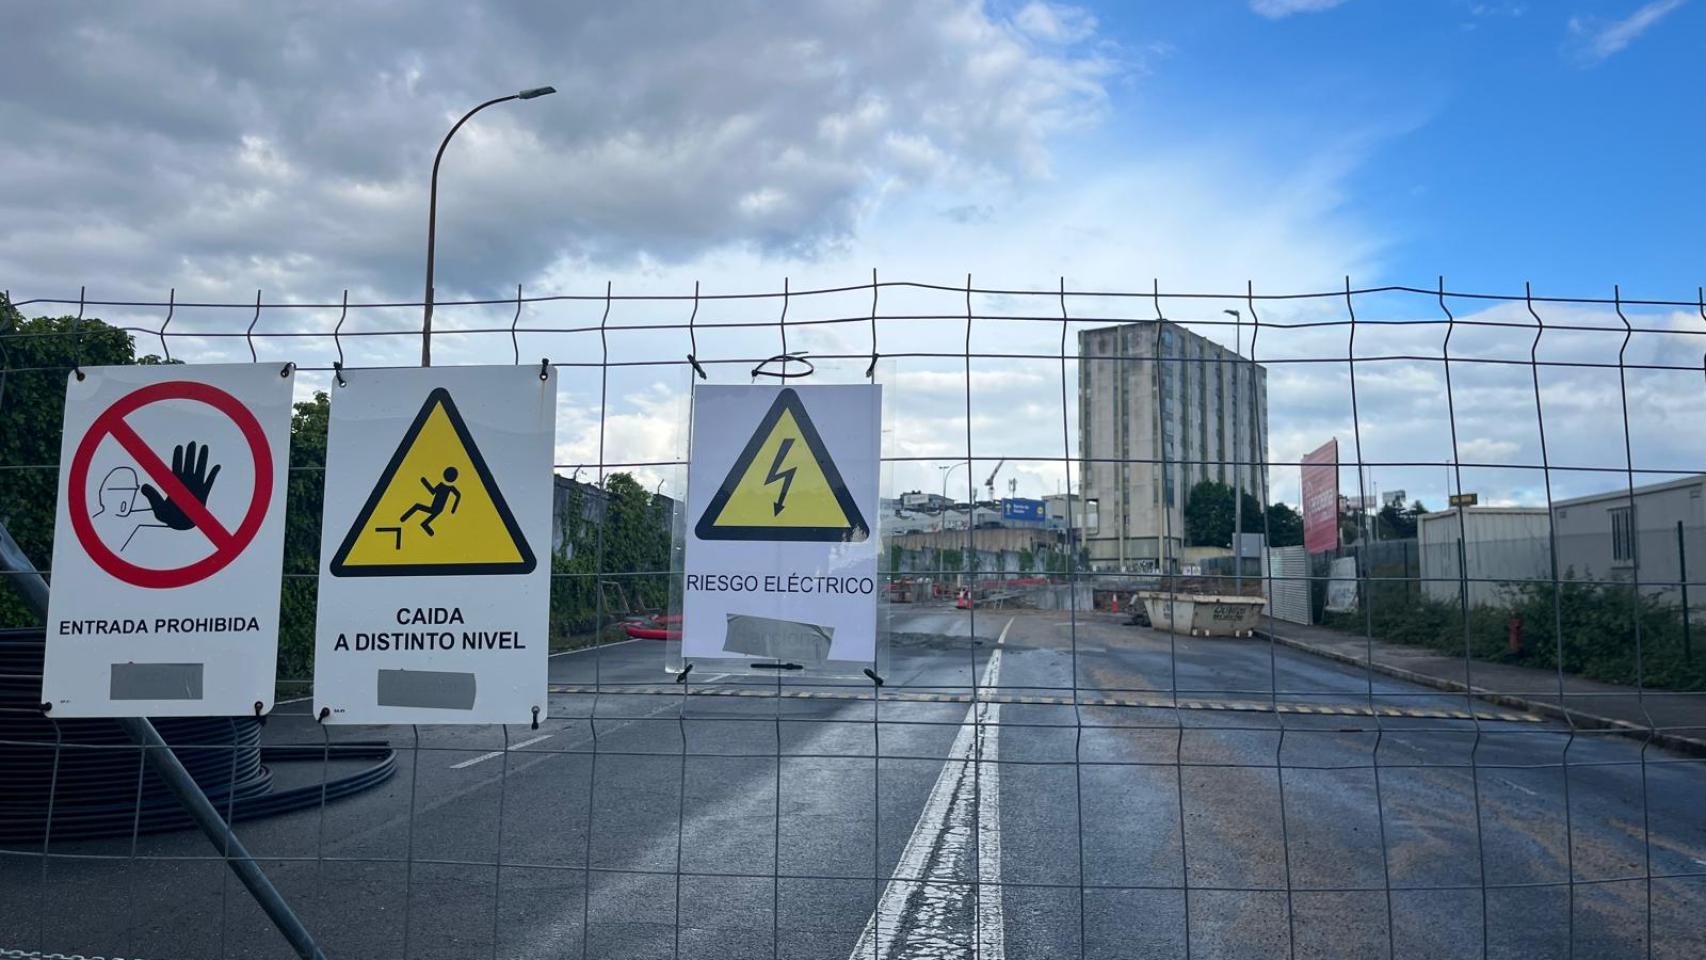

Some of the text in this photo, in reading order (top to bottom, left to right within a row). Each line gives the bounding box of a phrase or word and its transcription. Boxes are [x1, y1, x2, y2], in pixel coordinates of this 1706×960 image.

[687, 572, 874, 595] RIESGO ELÉCTRICO
[396, 607, 464, 625] CAIDA
[59, 617, 260, 636] ENTRADA PROHIBIDA
[334, 631, 526, 652] A DISTINTO NIVEL
